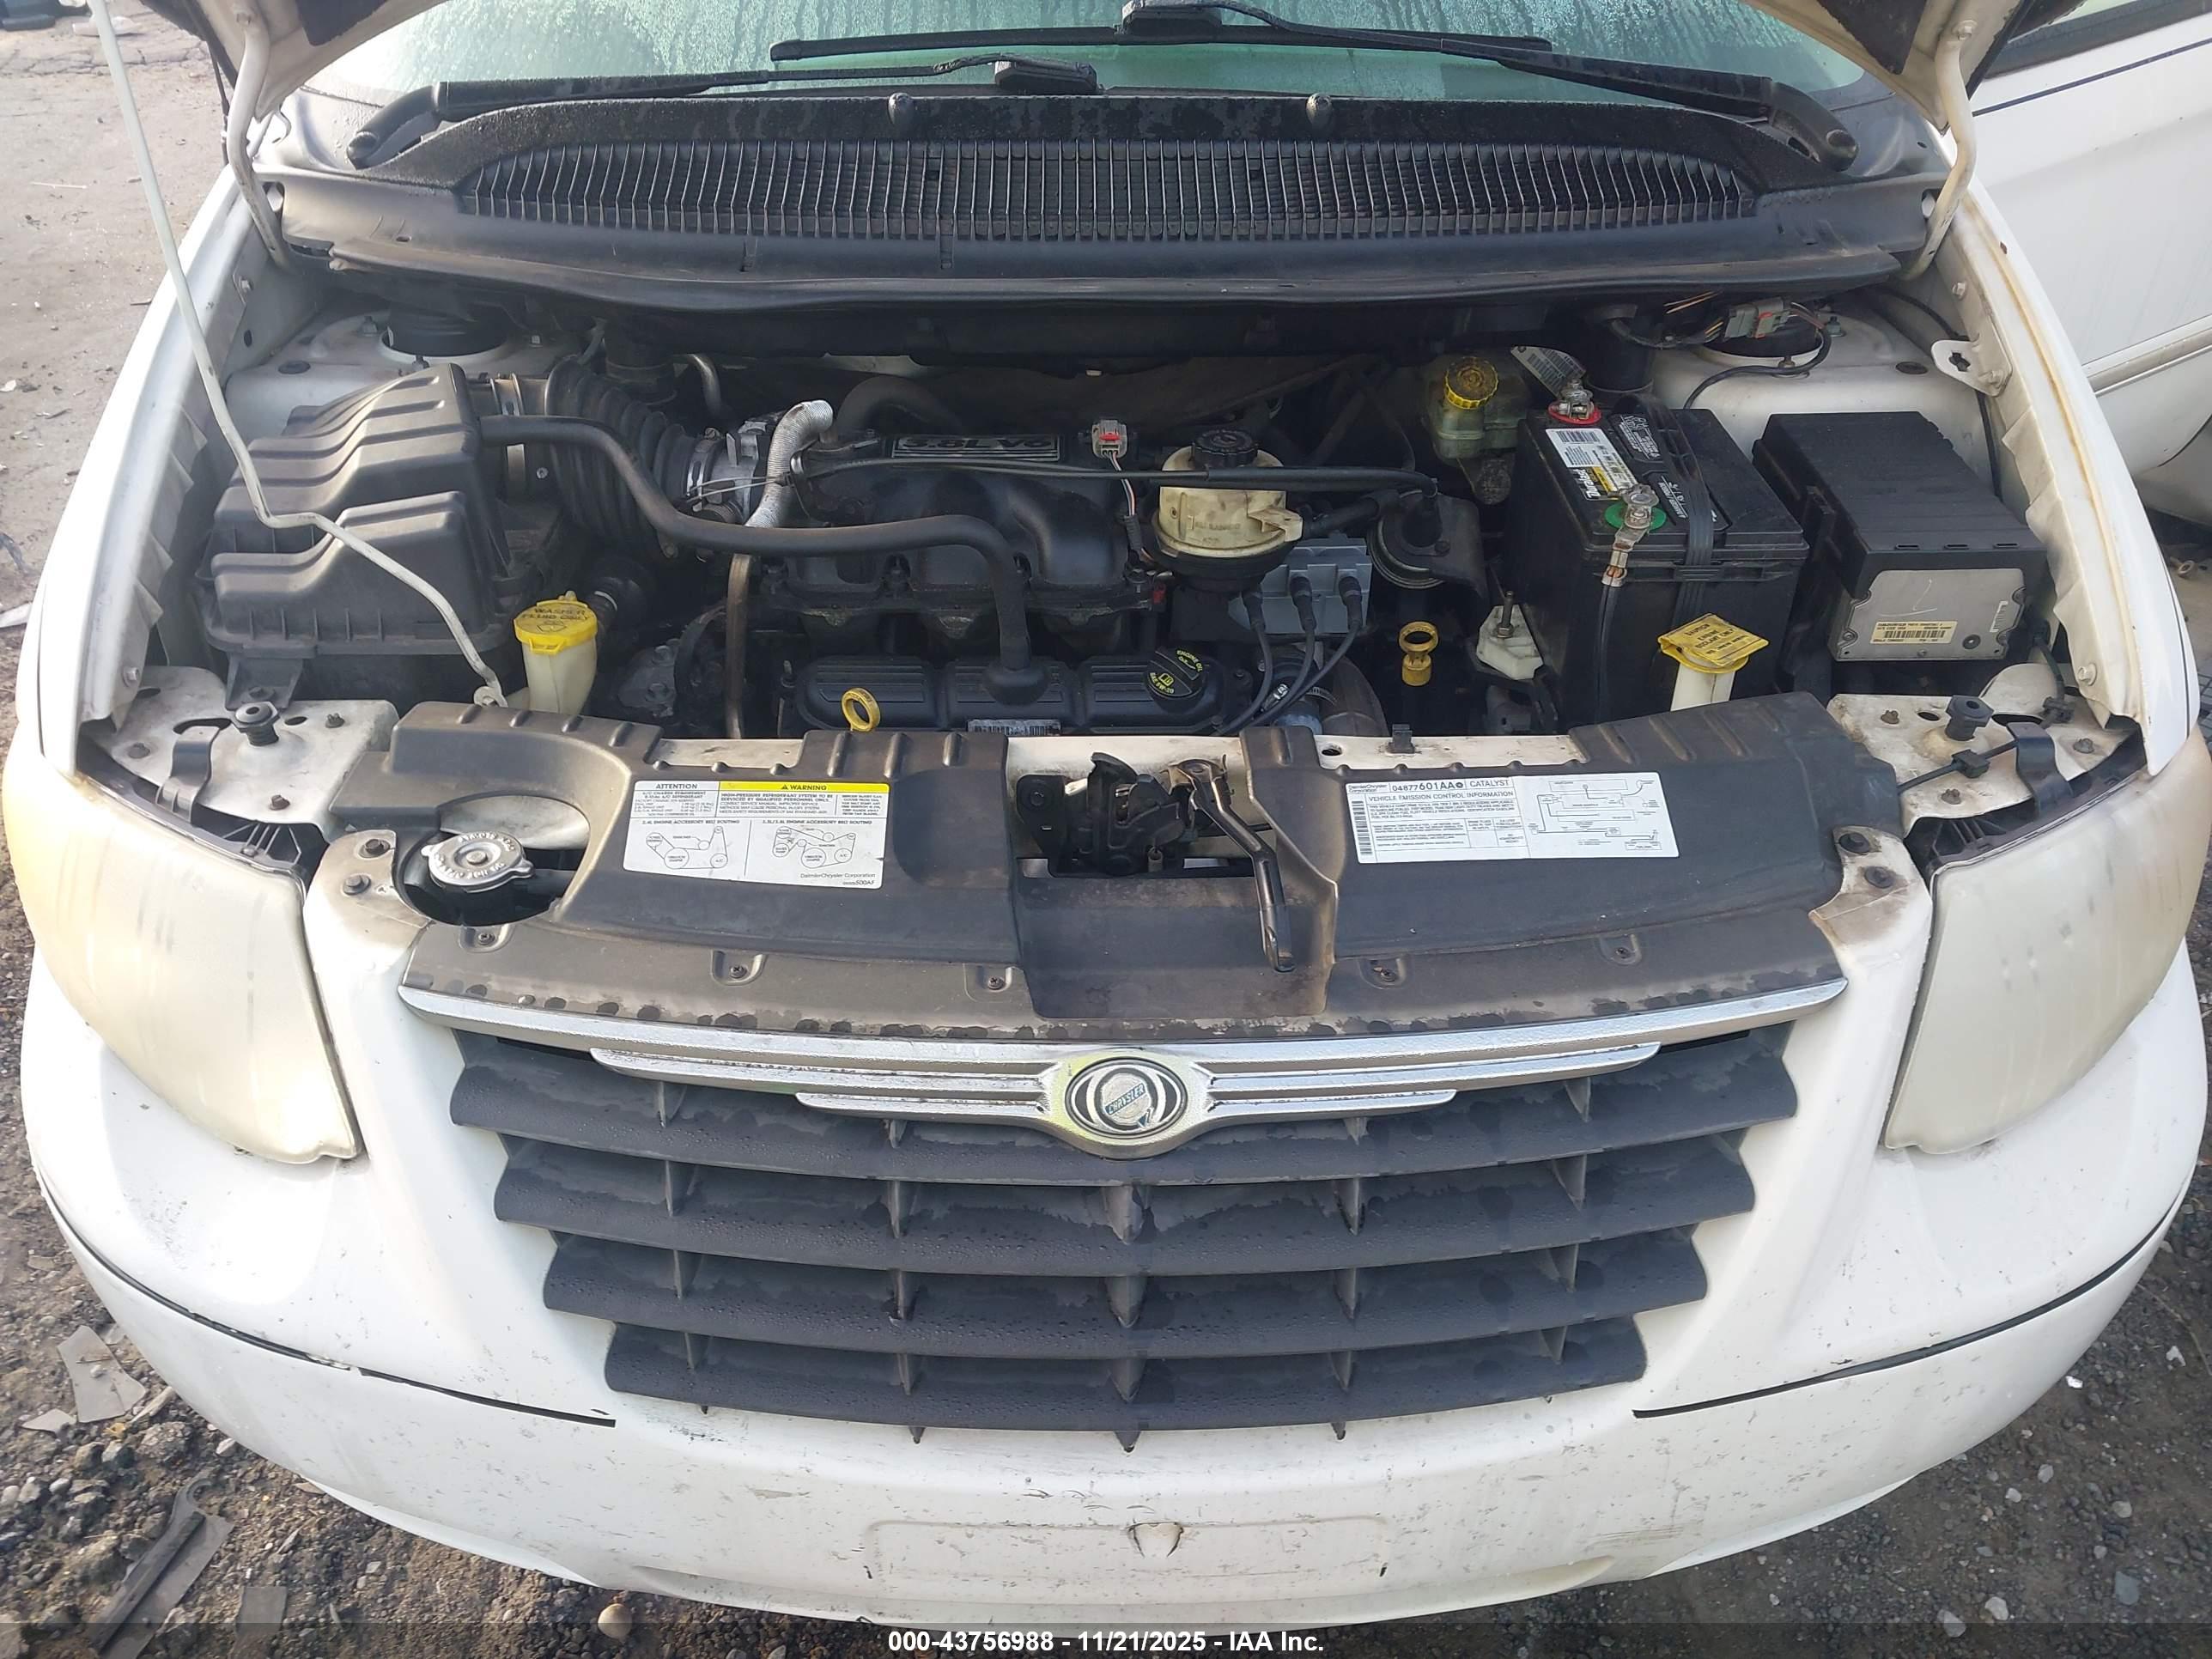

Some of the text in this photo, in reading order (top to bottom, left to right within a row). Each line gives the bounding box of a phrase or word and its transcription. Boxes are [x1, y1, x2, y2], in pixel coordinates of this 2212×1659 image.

[1573, 469, 1601, 498] Duralast
[1176, 650, 1199, 663] ENGINE
[1392, 781, 1455, 791] 04877601AA
[1107, 1083, 1146, 1115] CHRYSLER
